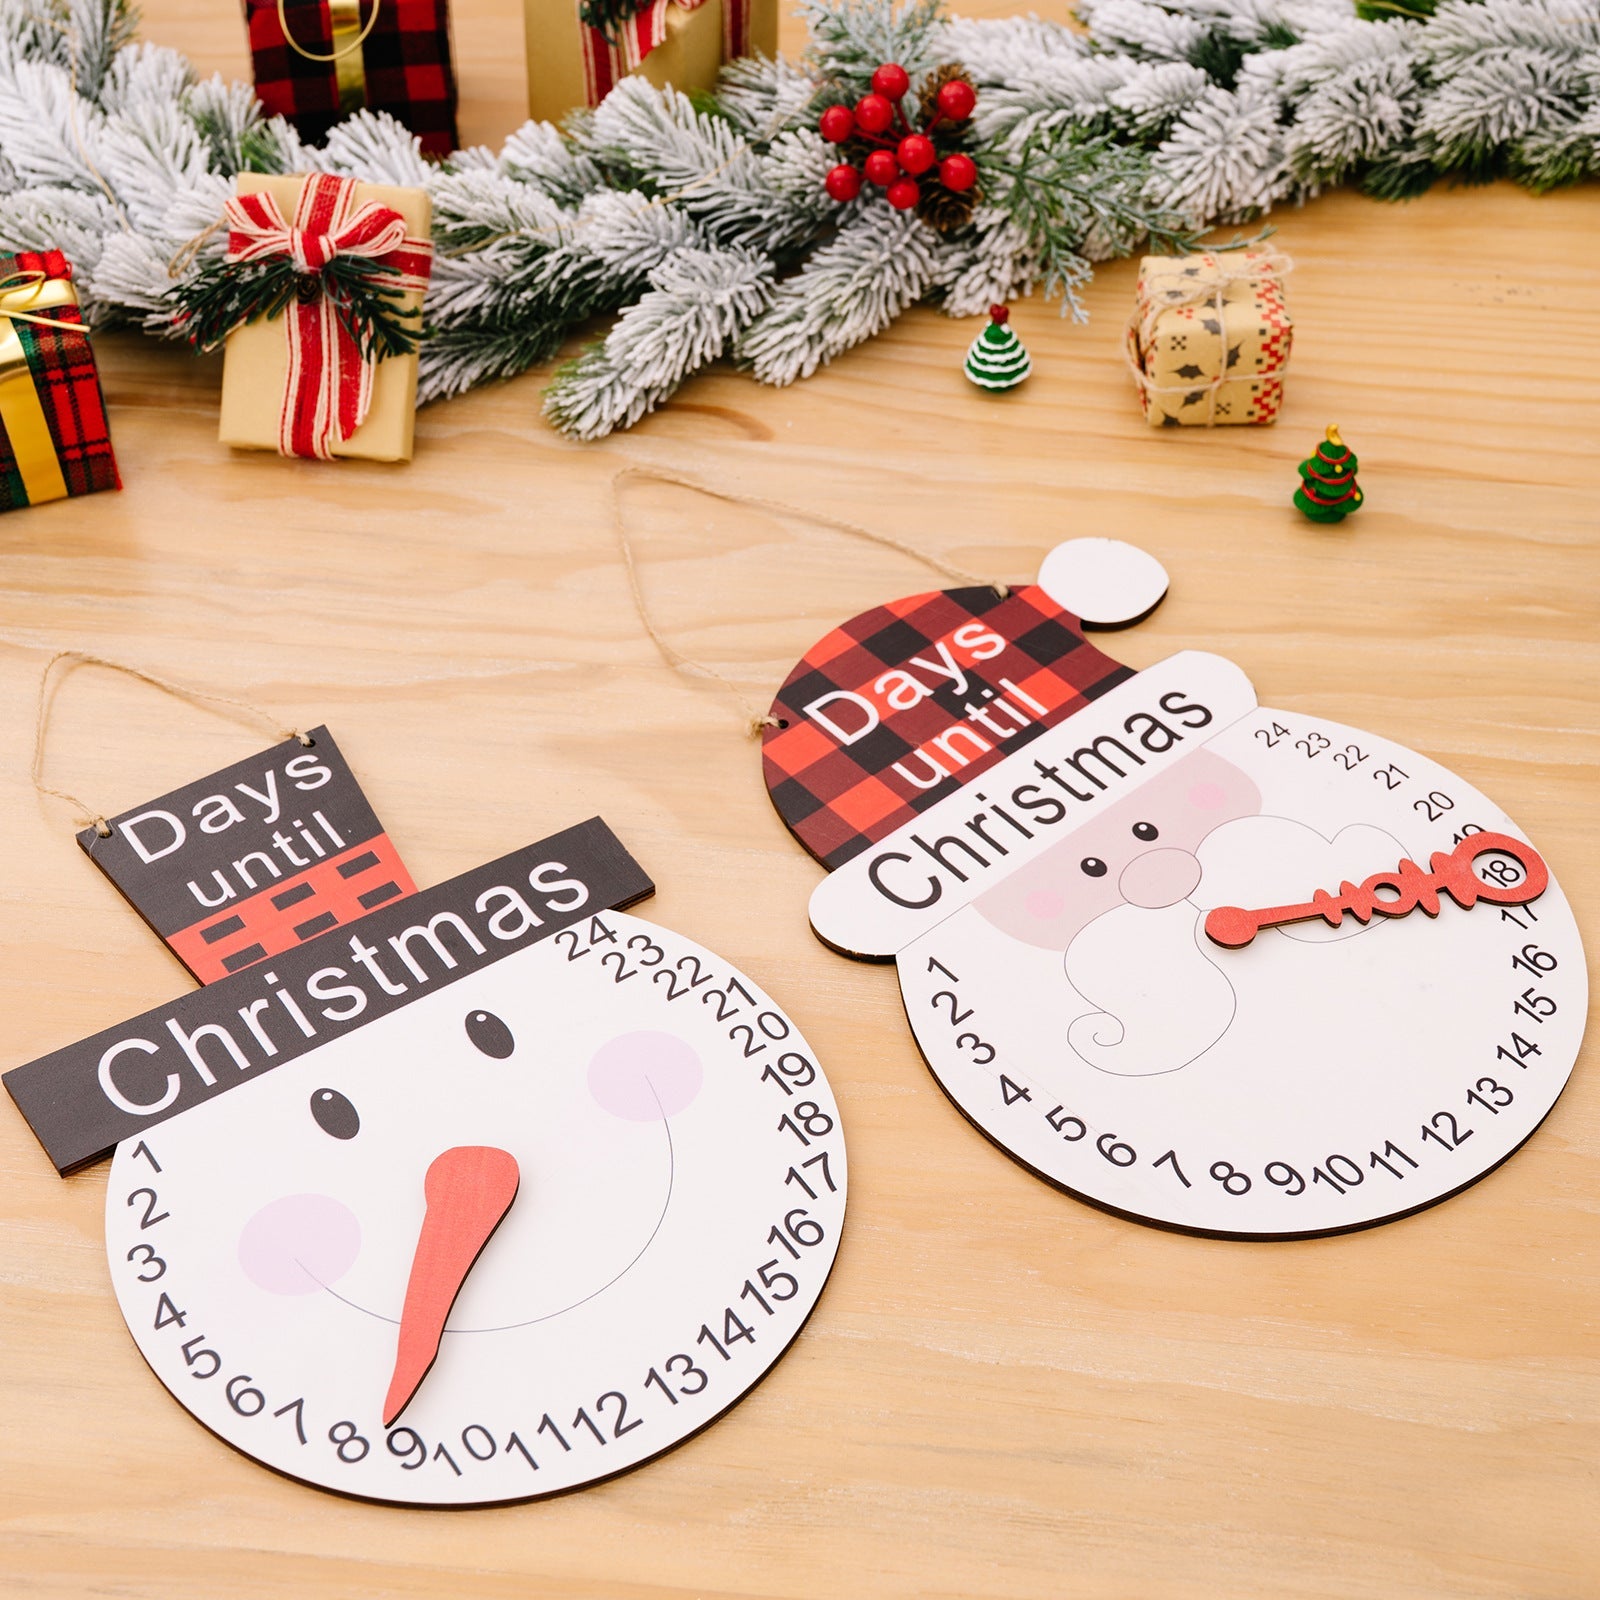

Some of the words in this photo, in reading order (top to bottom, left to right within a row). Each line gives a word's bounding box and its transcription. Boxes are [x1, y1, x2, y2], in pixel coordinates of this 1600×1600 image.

[802, 623, 1006, 746] Days
[891, 677, 1049, 789] until
[1254, 722, 1291, 748] 24
[1295, 732, 1331, 758] 23
[1333, 744, 1370, 771] 22
[1373, 764, 1410, 790] 21
[118, 754, 332, 864] Days
[868, 690, 1213, 910] Christmas
[1413, 791, 1454, 822] 20
[186, 810, 346, 907] until
[1481, 860, 1520, 888] 18
[555, 916, 618, 962] 24
[601, 935, 665, 984] 23
[652, 956, 714, 1002] 22
[927, 957, 960, 983] 1
[1512, 944, 1558, 979] 16
[97, 861, 589, 1116] Christmas
[702, 977, 758, 1023] 21
[931, 990, 975, 1027] 2
[1513, 987, 1558, 1024] 15
[729, 1012, 790, 1058] 20
[955, 1032, 996, 1065] 3
[1496, 1032, 1543, 1070] 14
[761, 1053, 815, 1096] 19
[999, 1073, 1033, 1106] 4
[1466, 1078, 1514, 1115] 13
[778, 1102, 833, 1147] 18
[1045, 1104, 1087, 1142] 5
[1422, 1112, 1475, 1152] 12
[131, 1141, 163, 1174] 1
[1096, 1133, 1137, 1168] 6
[1152, 1149, 1192, 1189] 7
[1369, 1139, 1420, 1180] 11
[785, 1152, 838, 1200] 17
[1209, 1160, 1252, 1196] 8
[1264, 1161, 1306, 1196] 9
[1313, 1155, 1365, 1195] 10
[127, 1188, 171, 1230] 2
[767, 1209, 824, 1260] 16
[127, 1244, 167, 1283] 3
[740, 1259, 799, 1316] 15
[153, 1292, 187, 1331] 4
[697, 1308, 756, 1361] 14
[182, 1335, 222, 1380] 5
[226, 1376, 266, 1417] 6
[643, 1354, 708, 1405] 13
[273, 1398, 308, 1445] 7
[572, 1392, 644, 1446] 12
[328, 1421, 370, 1464] 8
[386, 1427, 427, 1470] 9
[433, 1424, 497, 1477] 10
[504, 1413, 572, 1471] 11
